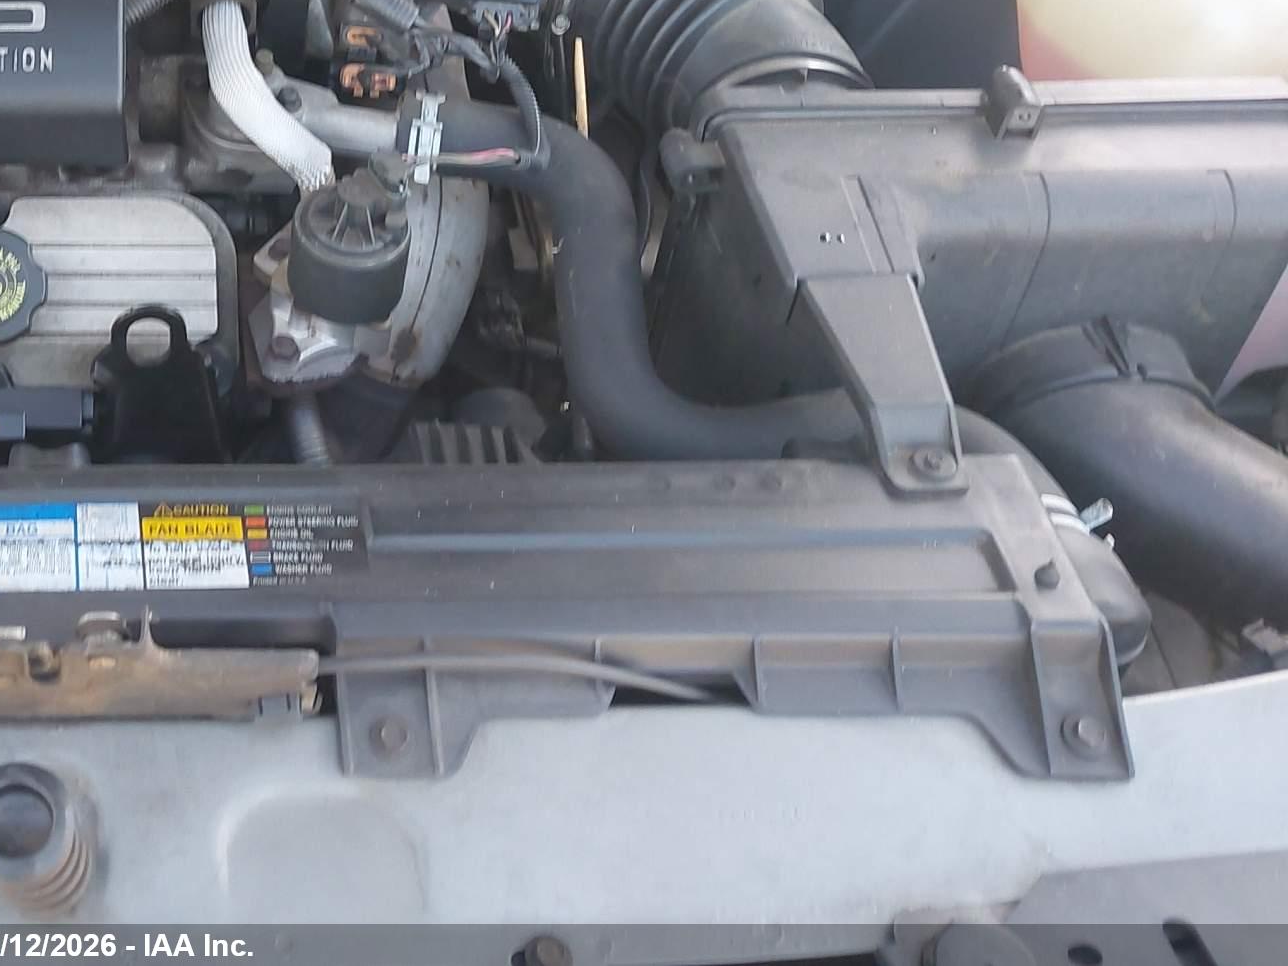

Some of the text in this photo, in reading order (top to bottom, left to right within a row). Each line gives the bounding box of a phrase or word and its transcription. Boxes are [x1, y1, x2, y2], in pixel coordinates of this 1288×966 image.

[172, 504, 229, 517] CAUTION
[5, 522, 39, 535] BAG
[148, 520, 234, 536] FAN BLADE
